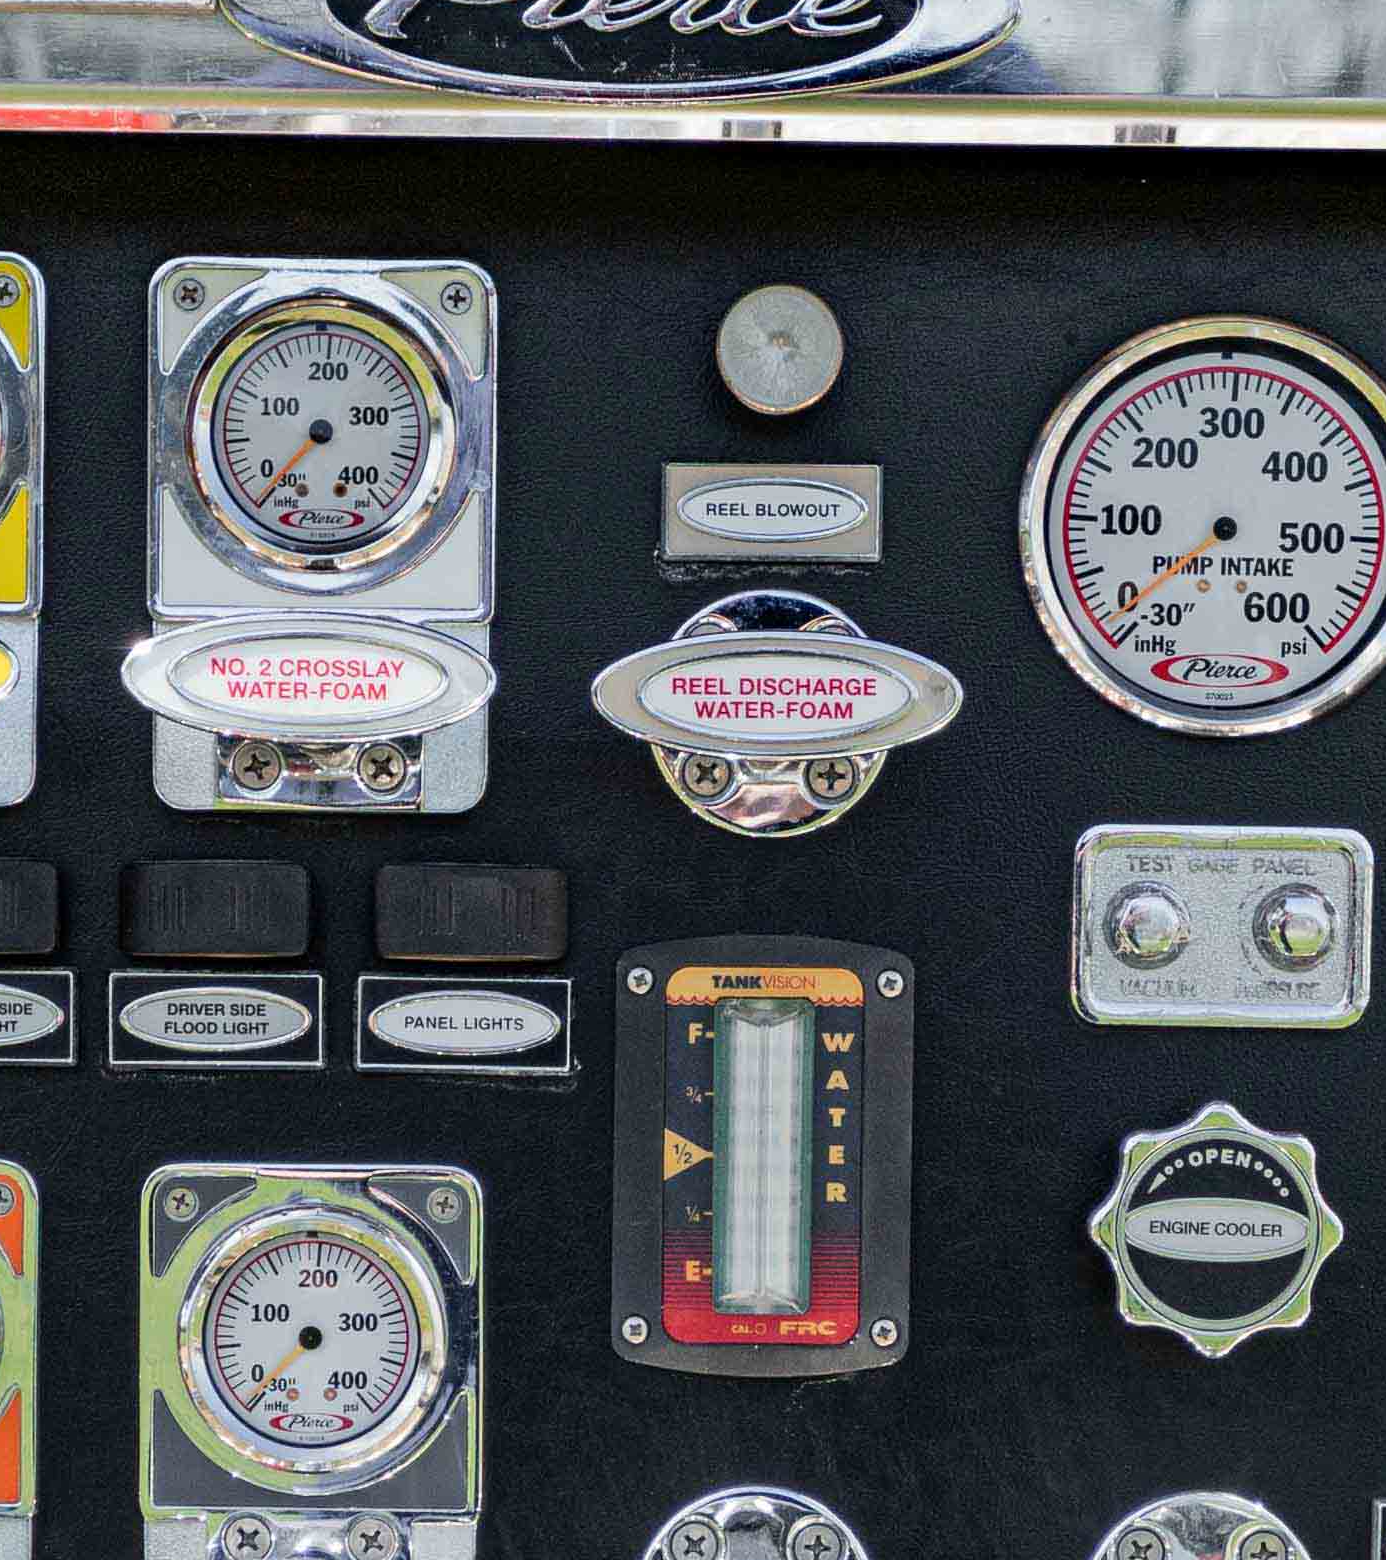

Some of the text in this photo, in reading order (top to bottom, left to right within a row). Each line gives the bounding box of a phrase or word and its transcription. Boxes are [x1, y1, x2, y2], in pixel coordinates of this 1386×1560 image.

[1198, 407, 1265, 439] 300
[1131, 438, 1199, 469] 200
[1261, 451, 1328, 482] 400
[707, 503, 840, 517] REEL BLOWOUT
[1100, 504, 1161, 536] 100
[1279, 522, 1345, 554] 500
[1153, 555, 1293, 577] PUMP INTAKE
[1244, 591, 1309, 623] 600
[1134, 635, 1176, 656] inHg
[1281, 636, 1308, 658] psi
[211, 658, 404, 677] NO. 2 CROSSLAY
[228, 681, 386, 699] WATER-FOAM
[673, 678, 876, 695] REEL DISCHARGE
[695, 702, 852, 719] WATER-FOAM
[168, 1000, 269, 1016] DRIVER SIDE
[165, 1022, 269, 1035] FLOOD LIGHT
[405, 1016, 523, 1030] PANEL LIGHTS
[1188, 1148, 1252, 1169] OPEN
[1150, 1221, 1282, 1237] ENGINE COOLER
